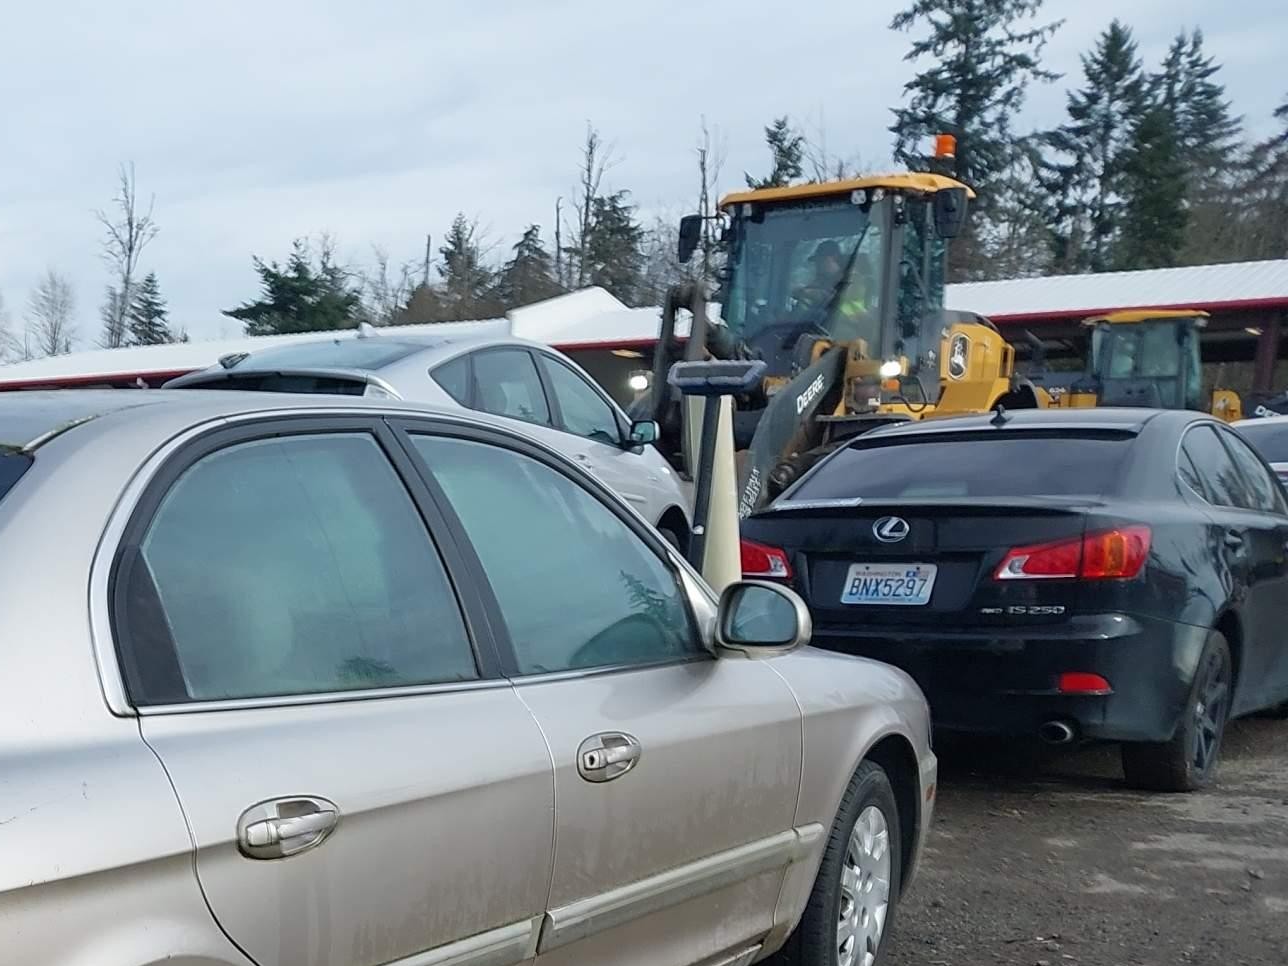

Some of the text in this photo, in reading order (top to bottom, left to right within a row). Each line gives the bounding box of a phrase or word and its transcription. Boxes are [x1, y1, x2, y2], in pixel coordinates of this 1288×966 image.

[796, 374, 825, 415] DEERE
[849, 578, 927, 597] BNX5297
[1029, 606, 1065, 614] 250
